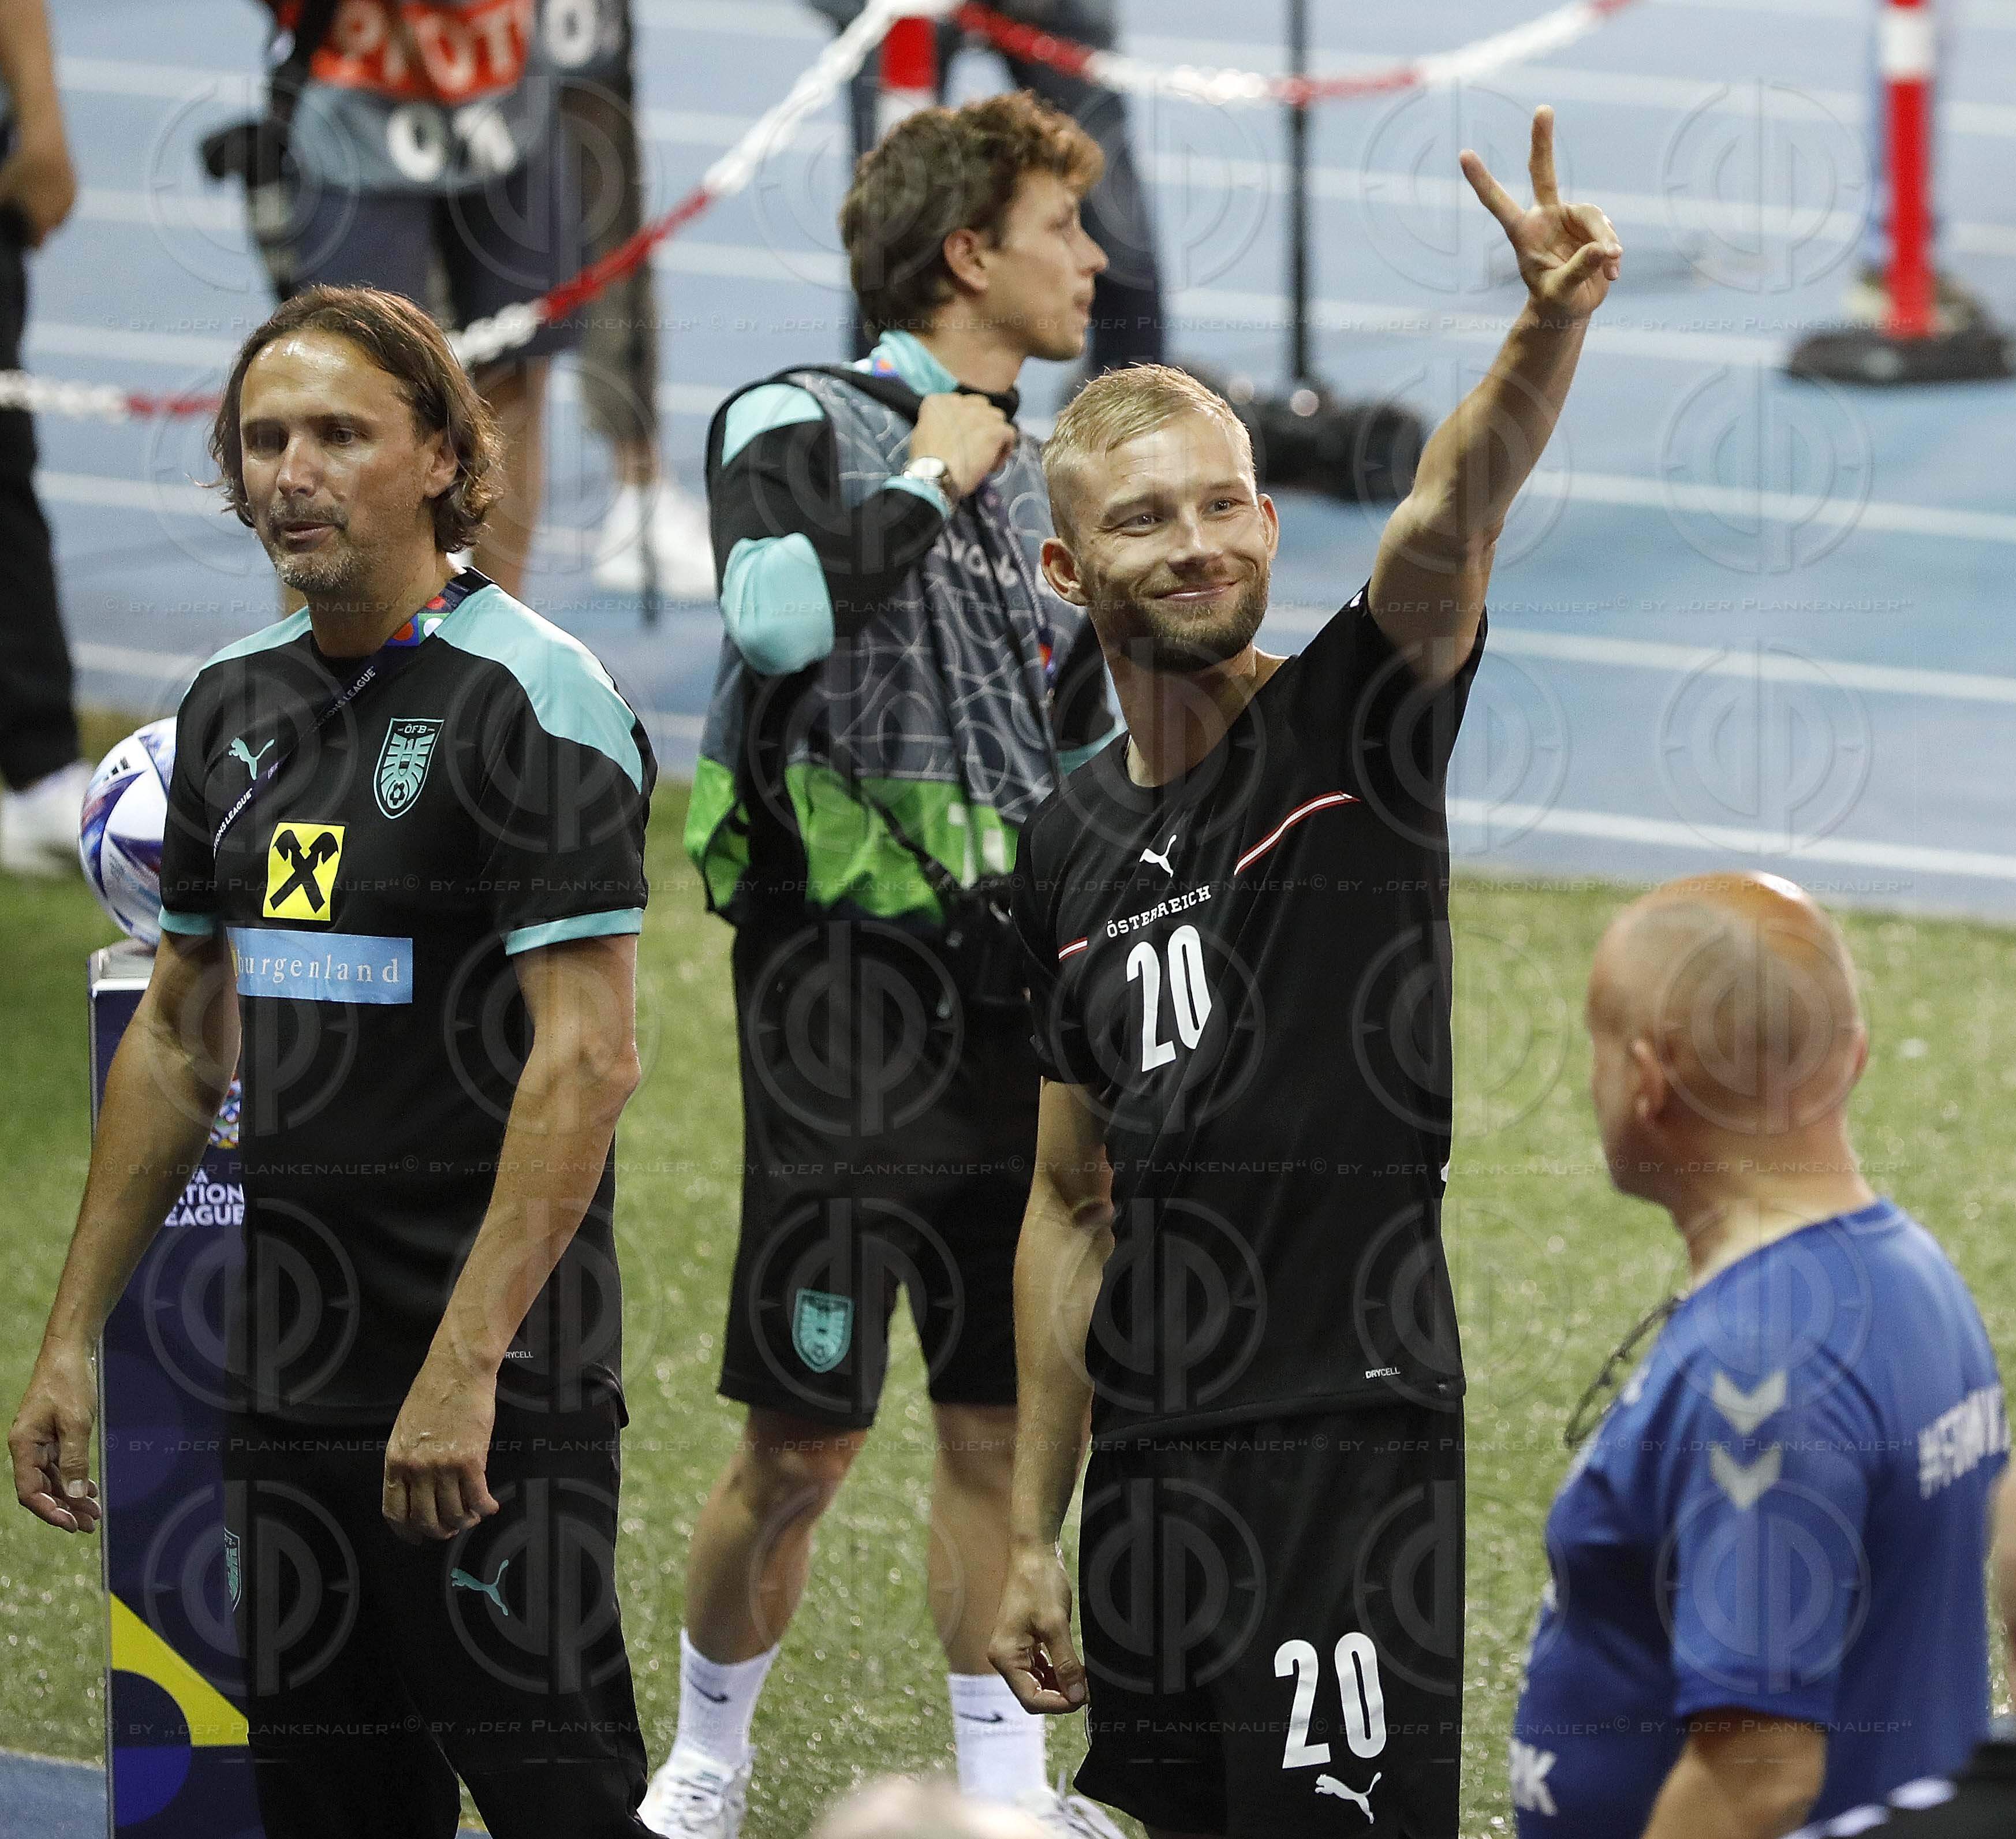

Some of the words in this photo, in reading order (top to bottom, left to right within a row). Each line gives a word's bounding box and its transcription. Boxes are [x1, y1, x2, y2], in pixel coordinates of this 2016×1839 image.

[343, 667, 376, 700] LEAGUE
[225, 790, 252, 825] LEAGUE
[1107, 885, 1212, 938] ÖSTERREICH
[1126, 924, 1212, 1072] 20
[505, 1351, 533, 1359] RYCELL
[1365, 1367, 1401, 1379] DRYCELL
[1274, 1632, 1387, 1769] 20
